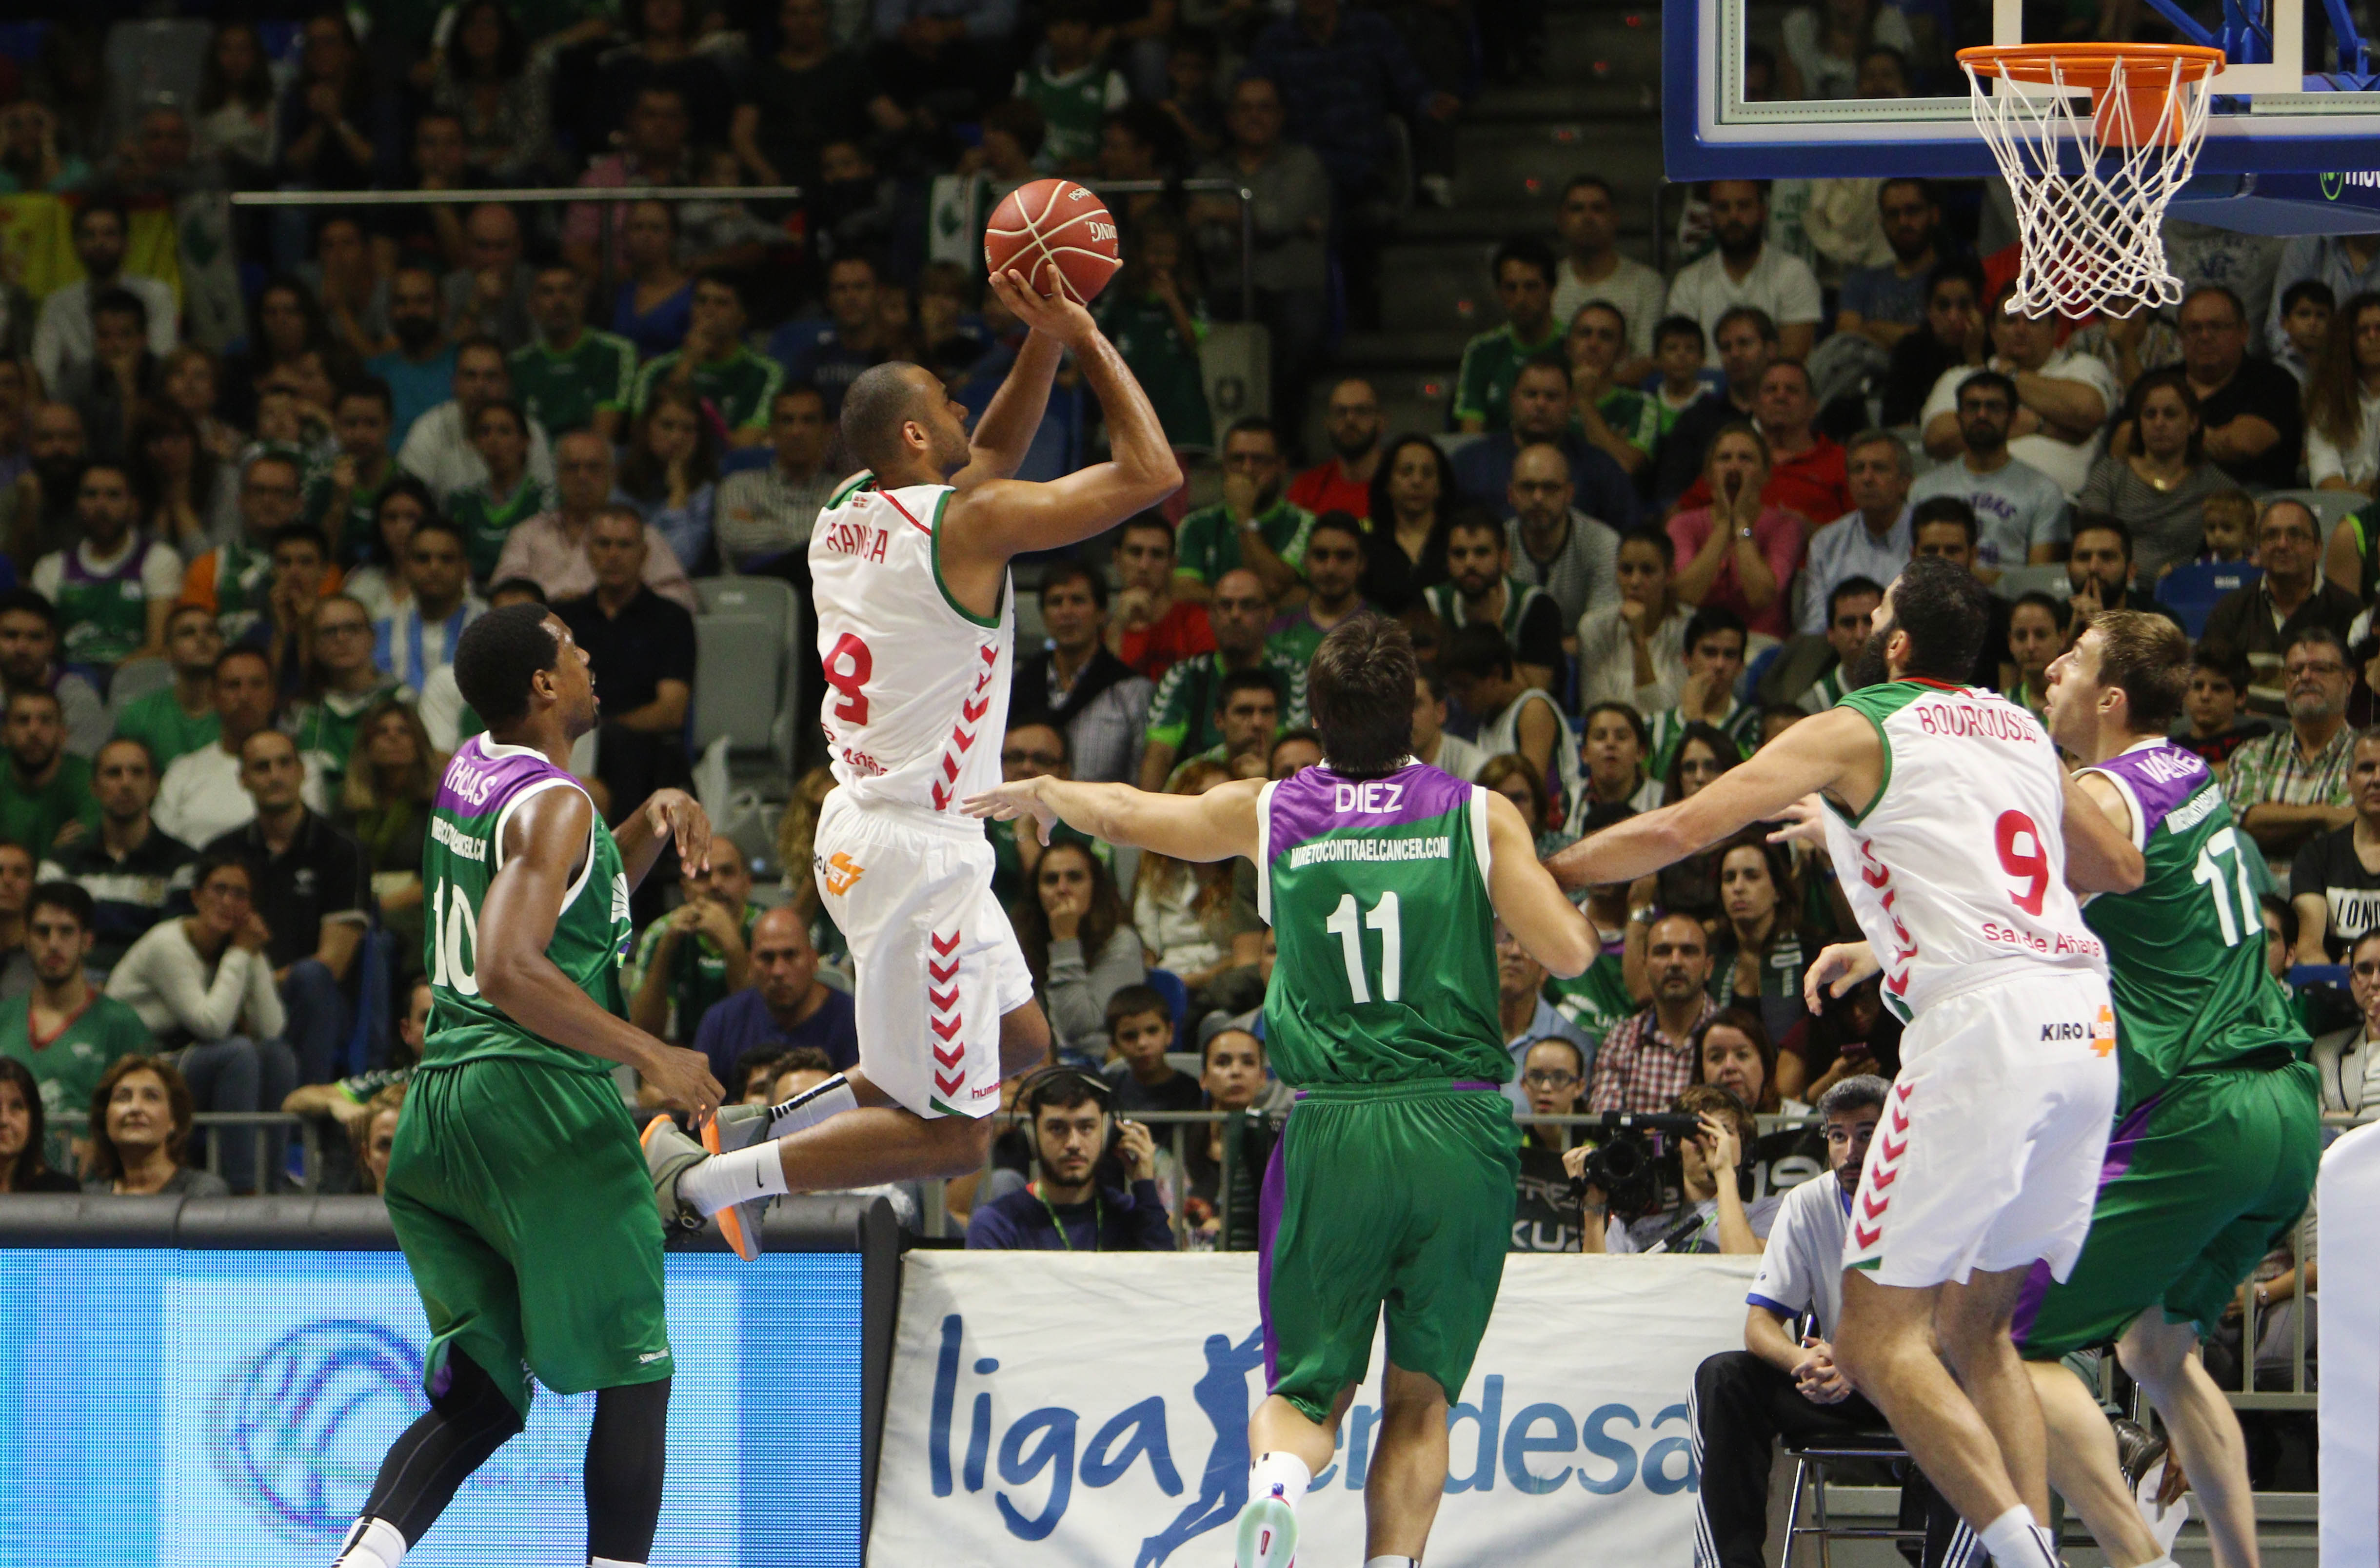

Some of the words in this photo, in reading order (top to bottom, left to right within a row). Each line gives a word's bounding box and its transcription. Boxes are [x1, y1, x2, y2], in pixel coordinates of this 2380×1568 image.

[444, 755, 497, 806] THOAS
[1335, 783, 1403, 813] DIEZ
[1290, 836, 1449, 870] MIRETOCONTRAELCANCER.COM
[1995, 809, 2050, 917] 9
[2192, 826, 2263, 947] 17
[433, 876, 479, 996] 10
[1326, 891, 1402, 1004] 11
[929, 1313, 1184, 1542] liga
[1307, 1374, 1699, 1495] desa
